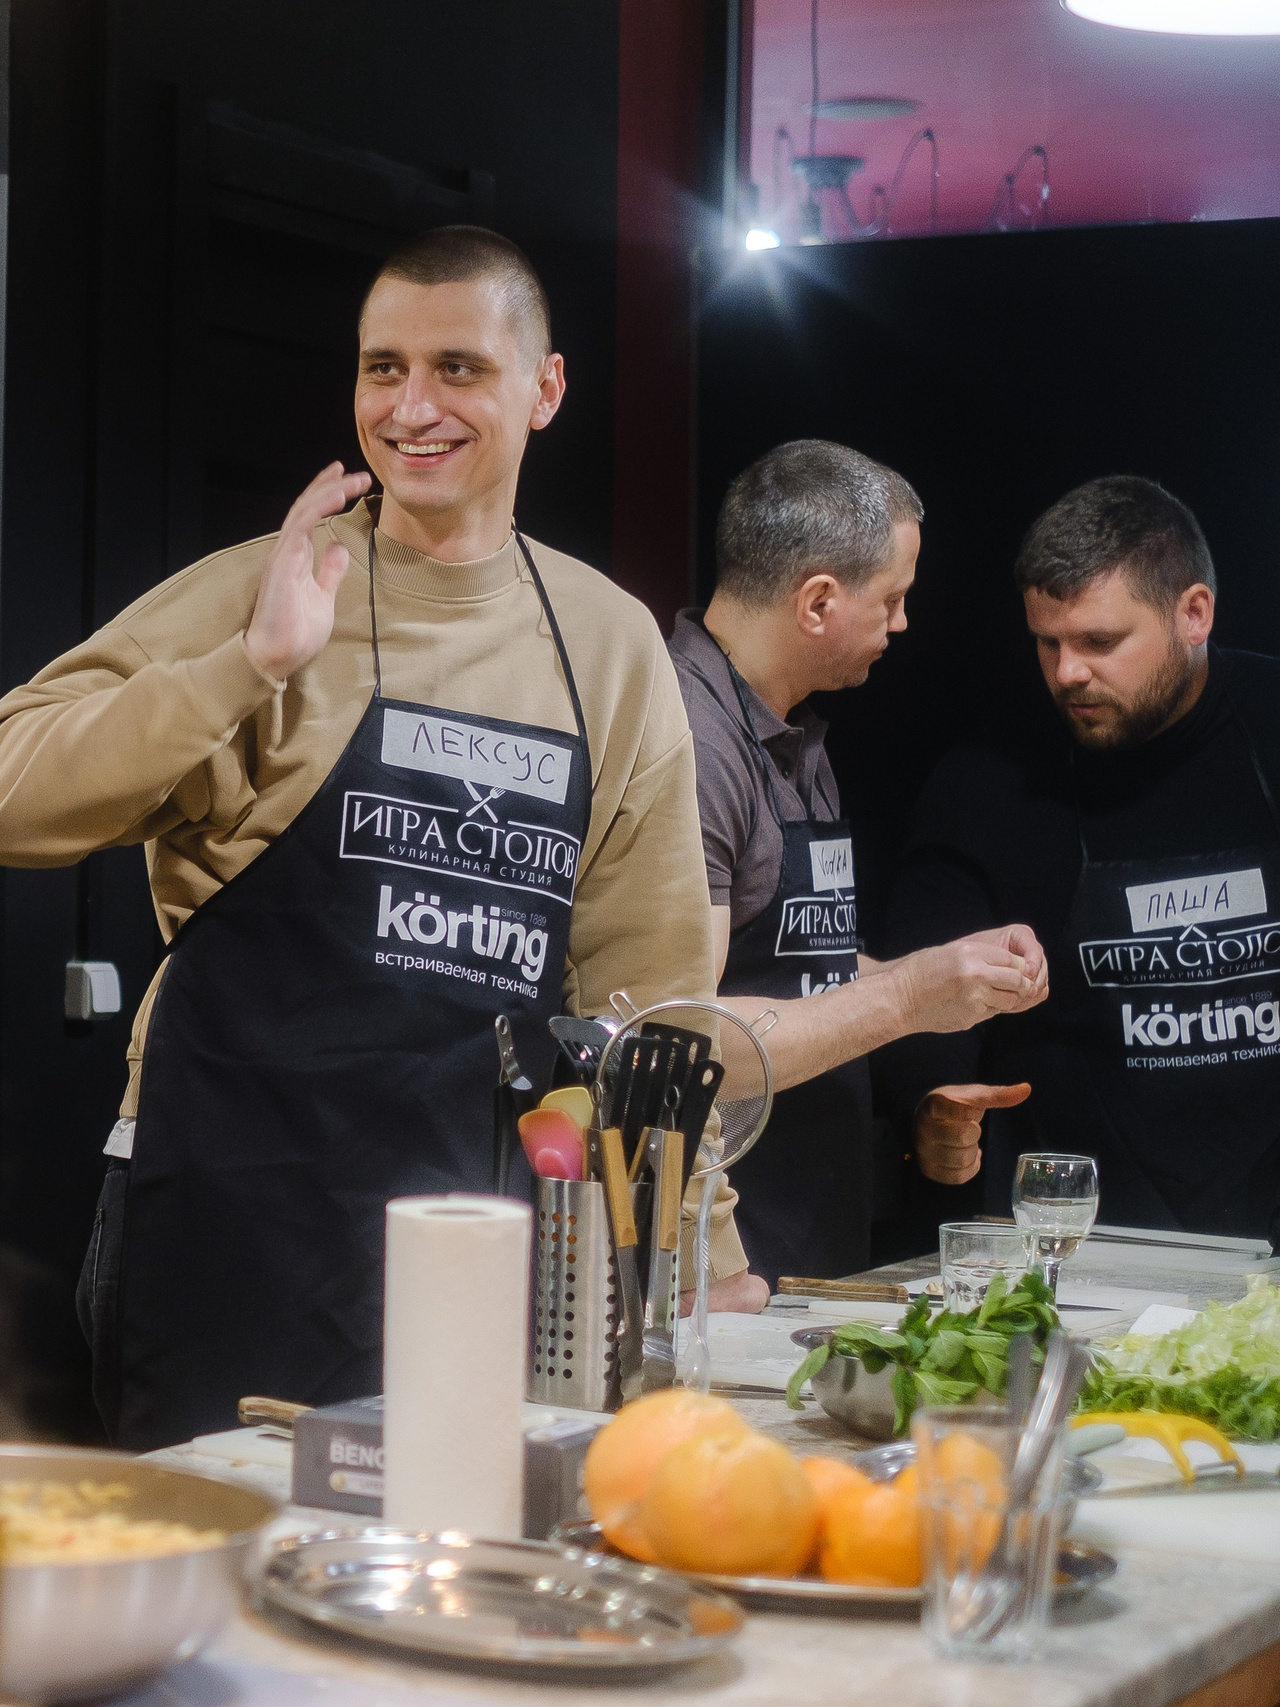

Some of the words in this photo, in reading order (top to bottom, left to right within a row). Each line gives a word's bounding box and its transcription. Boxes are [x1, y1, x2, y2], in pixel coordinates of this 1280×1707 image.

[412, 721, 556, 784] ЛЕКСУС
[353, 801, 447, 849] ИГРА
[456, 821, 576, 879] СТОЛОВ
[388, 843, 491, 874] КУЛИНАРНАЯ
[500, 866, 552, 887] СТУДИЯ
[500, 906, 526, 922] since
[529, 912, 548, 927] 1889
[787, 905, 833, 935] ИГРА
[1148, 880, 1229, 924] ПАША
[376, 885, 549, 982] körting
[1088, 944, 1170, 972] ИГРА
[1176, 930, 1280, 967] СТОЛО
[375, 952, 487, 985] встраиваемая
[490, 973, 538, 999] техника
[1220, 960, 1265, 975] СТУДИЯ
[1122, 999, 1280, 1046] körting
[1126, 1051, 1228, 1071] встраиваемая
